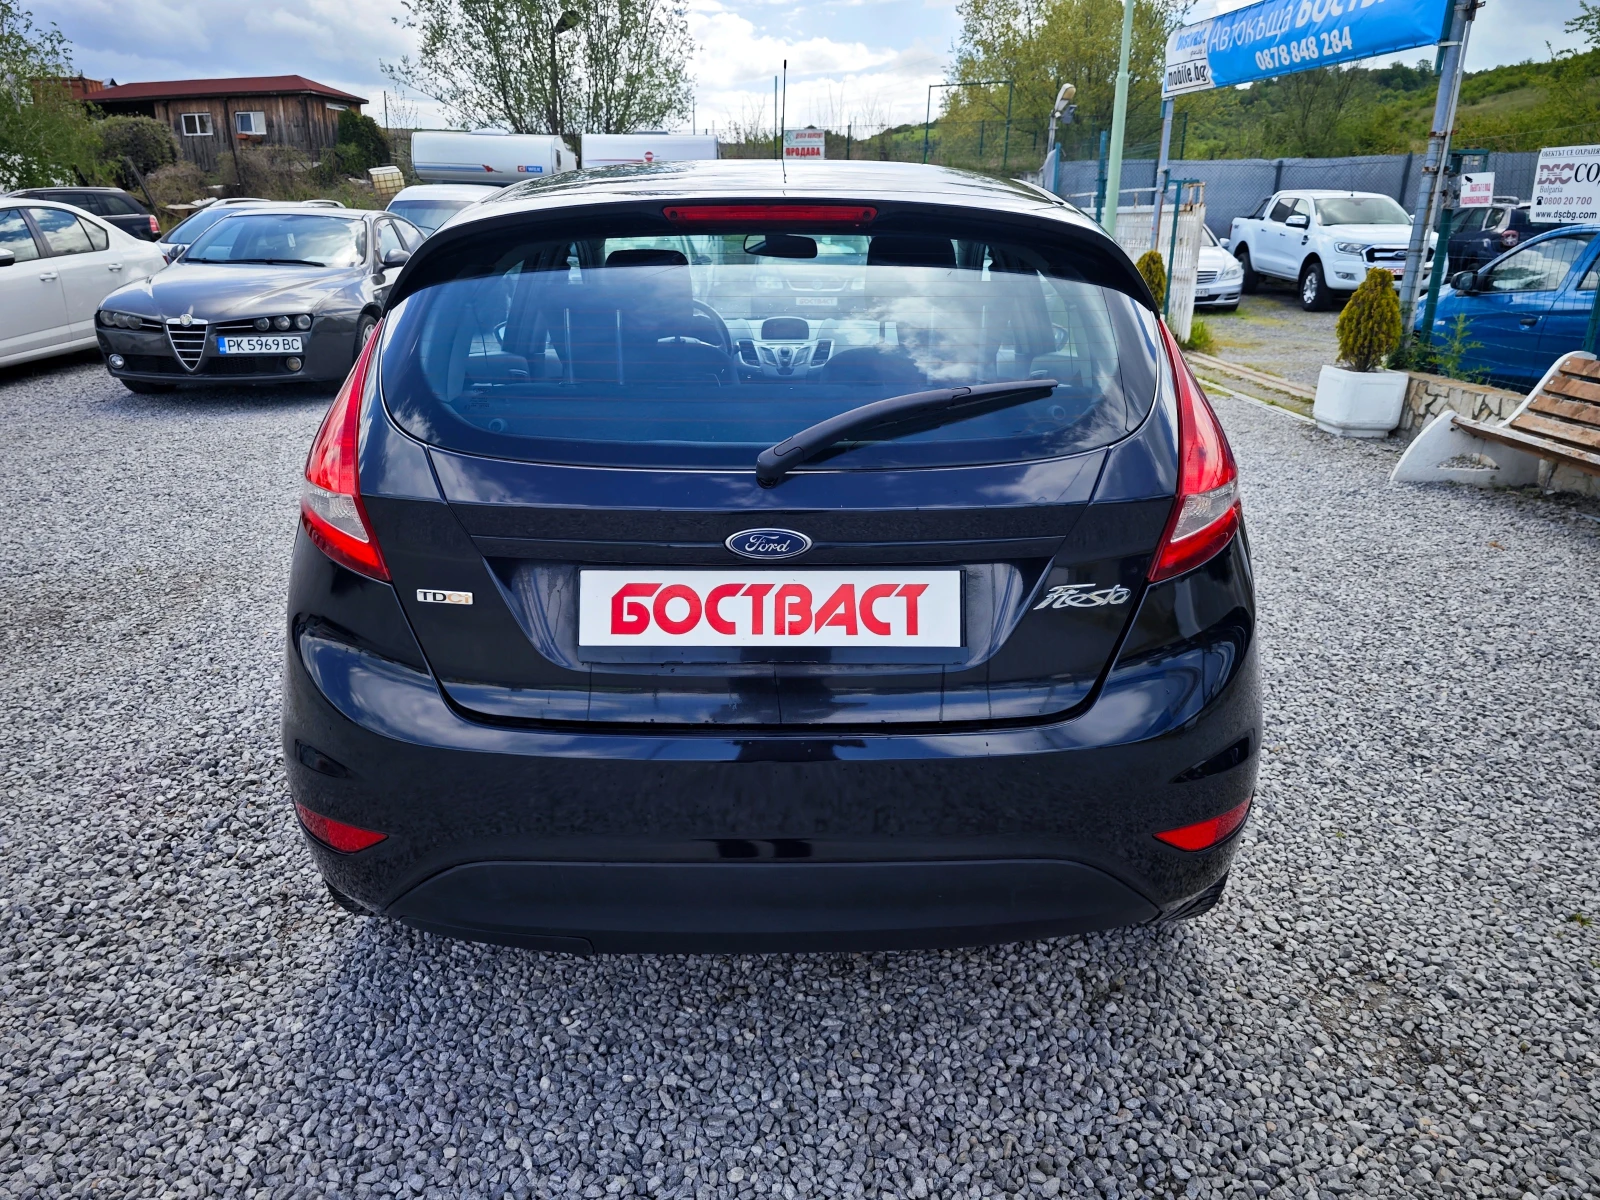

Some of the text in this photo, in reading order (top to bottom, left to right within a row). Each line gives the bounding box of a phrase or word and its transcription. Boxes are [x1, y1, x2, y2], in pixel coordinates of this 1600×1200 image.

[1255, 26, 1352, 71] 0878 848 284
[1168, 62, 1207, 87] mobile.bg
[785, 147, 821, 157] ПРОДАВА
[1537, 163, 1575, 185] DSC
[1574, 162, 1600, 187] СО
[1540, 185, 1563, 194] Bulgaria
[1544, 196, 1593, 205] 0800 20 700
[1535, 210, 1597, 220] www.dscbg.com
[227, 339, 245, 351] PK
[247, 339, 280, 351] 5969
[282, 338, 300, 351] BC
[744, 534, 791, 552] Ford
[418, 590, 470, 604] TDCi
[1033, 583, 1132, 610] Fiesta
[611, 583, 930, 636] БОСТВАСТ
